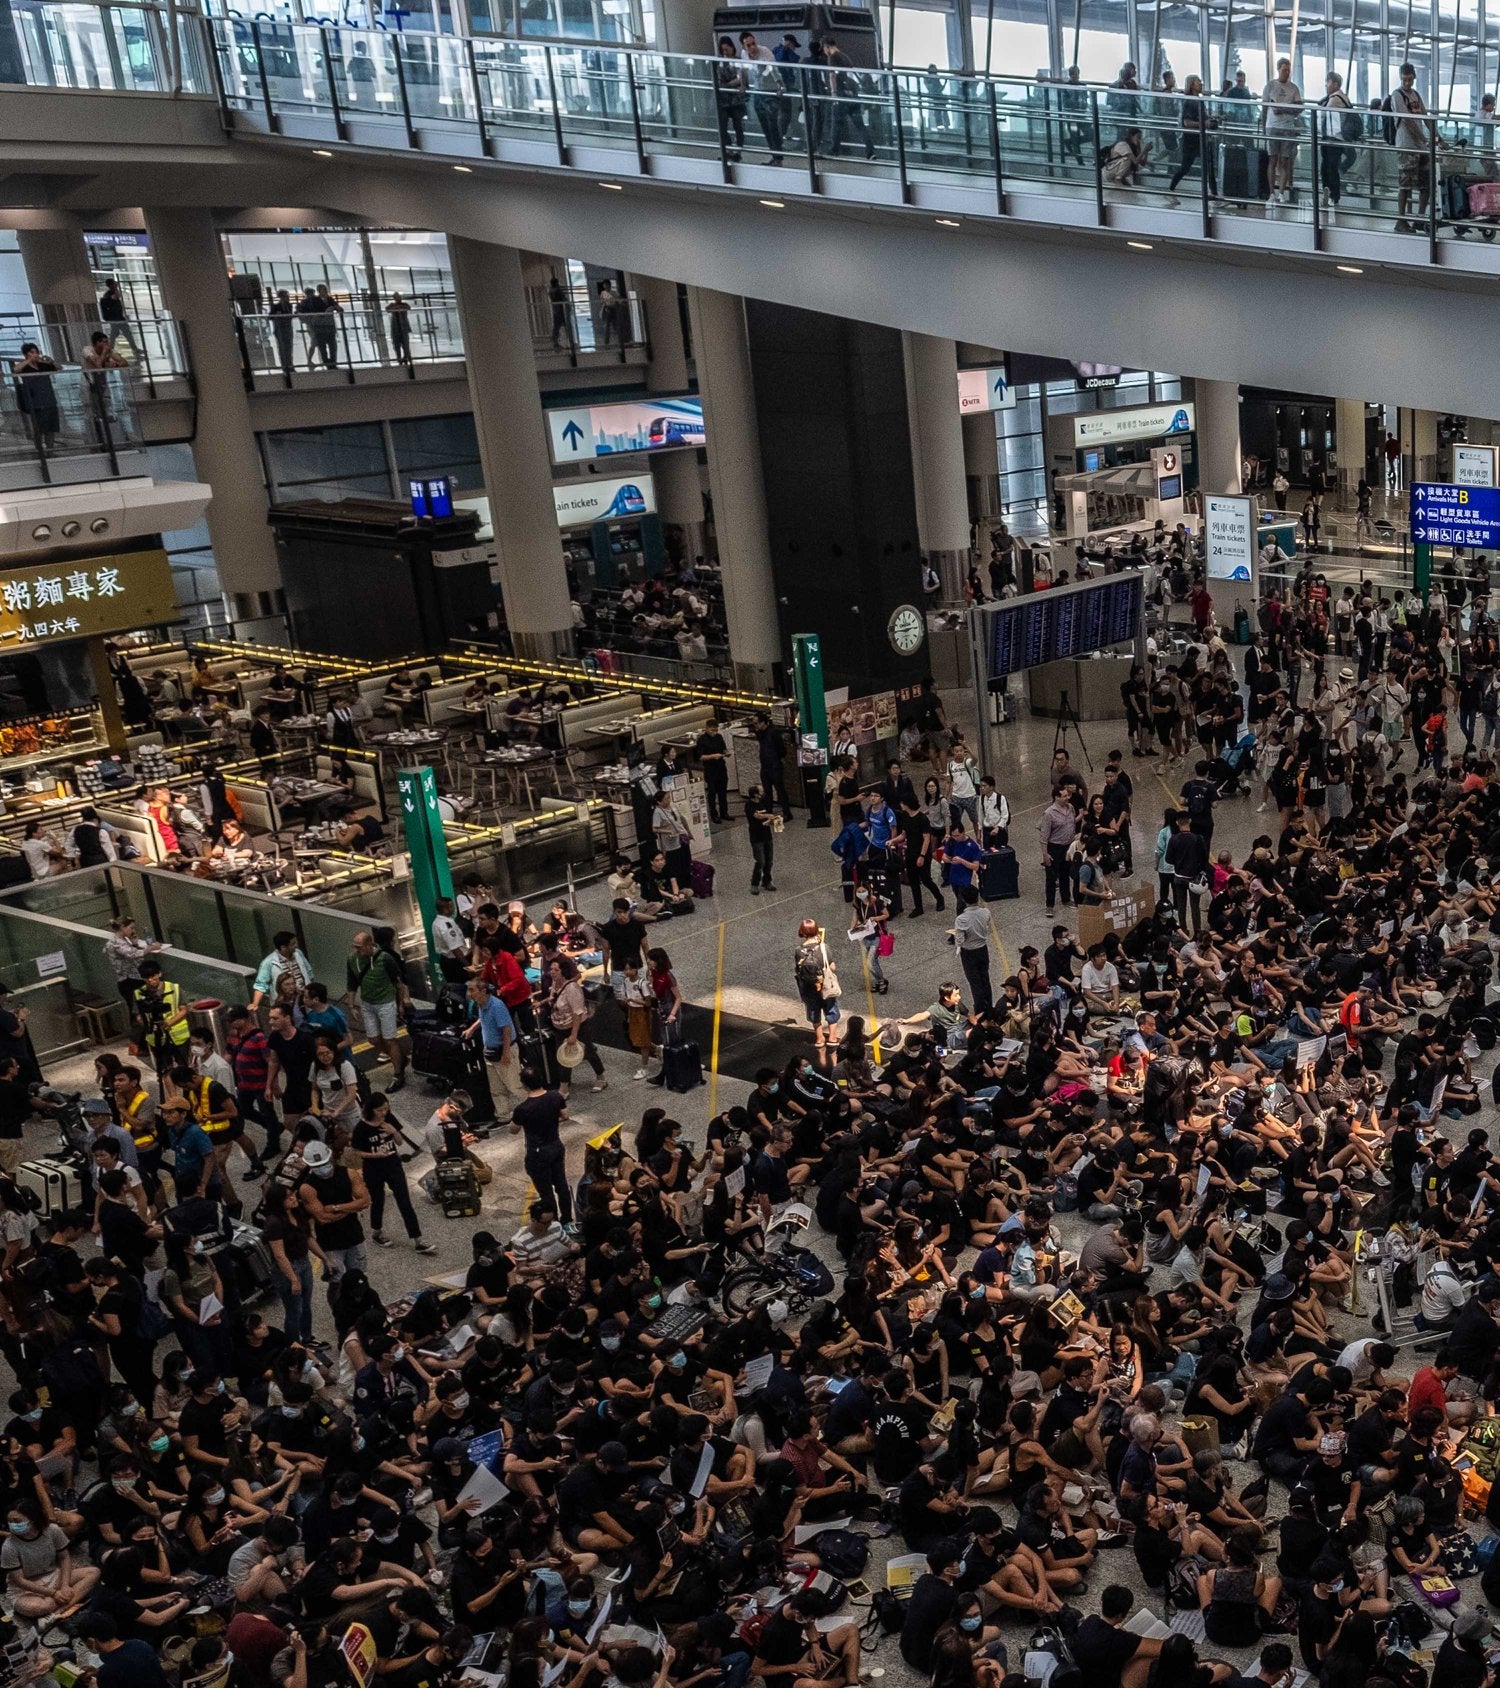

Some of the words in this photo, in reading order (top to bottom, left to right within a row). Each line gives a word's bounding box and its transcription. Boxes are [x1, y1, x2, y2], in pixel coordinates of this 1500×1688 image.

[1085, 378, 1116, 388] JCDecaux
[1138, 419, 1150, 427] Train
[1150, 418, 1165, 426] tickets
[1459, 490, 1469, 504] B
[571, 497, 598, 509] tickets
[1211, 533, 1226, 541] Train
[1227, 535, 1246, 543] tickets
[1466, 530, 1490, 540] 洗手間
[1213, 546, 1222, 555] 24
[3, 567, 125, 611] 粥麵專家
[2, 616, 81, 641] 一九四六年
[874, 1414, 910, 1438] CHAMPION
